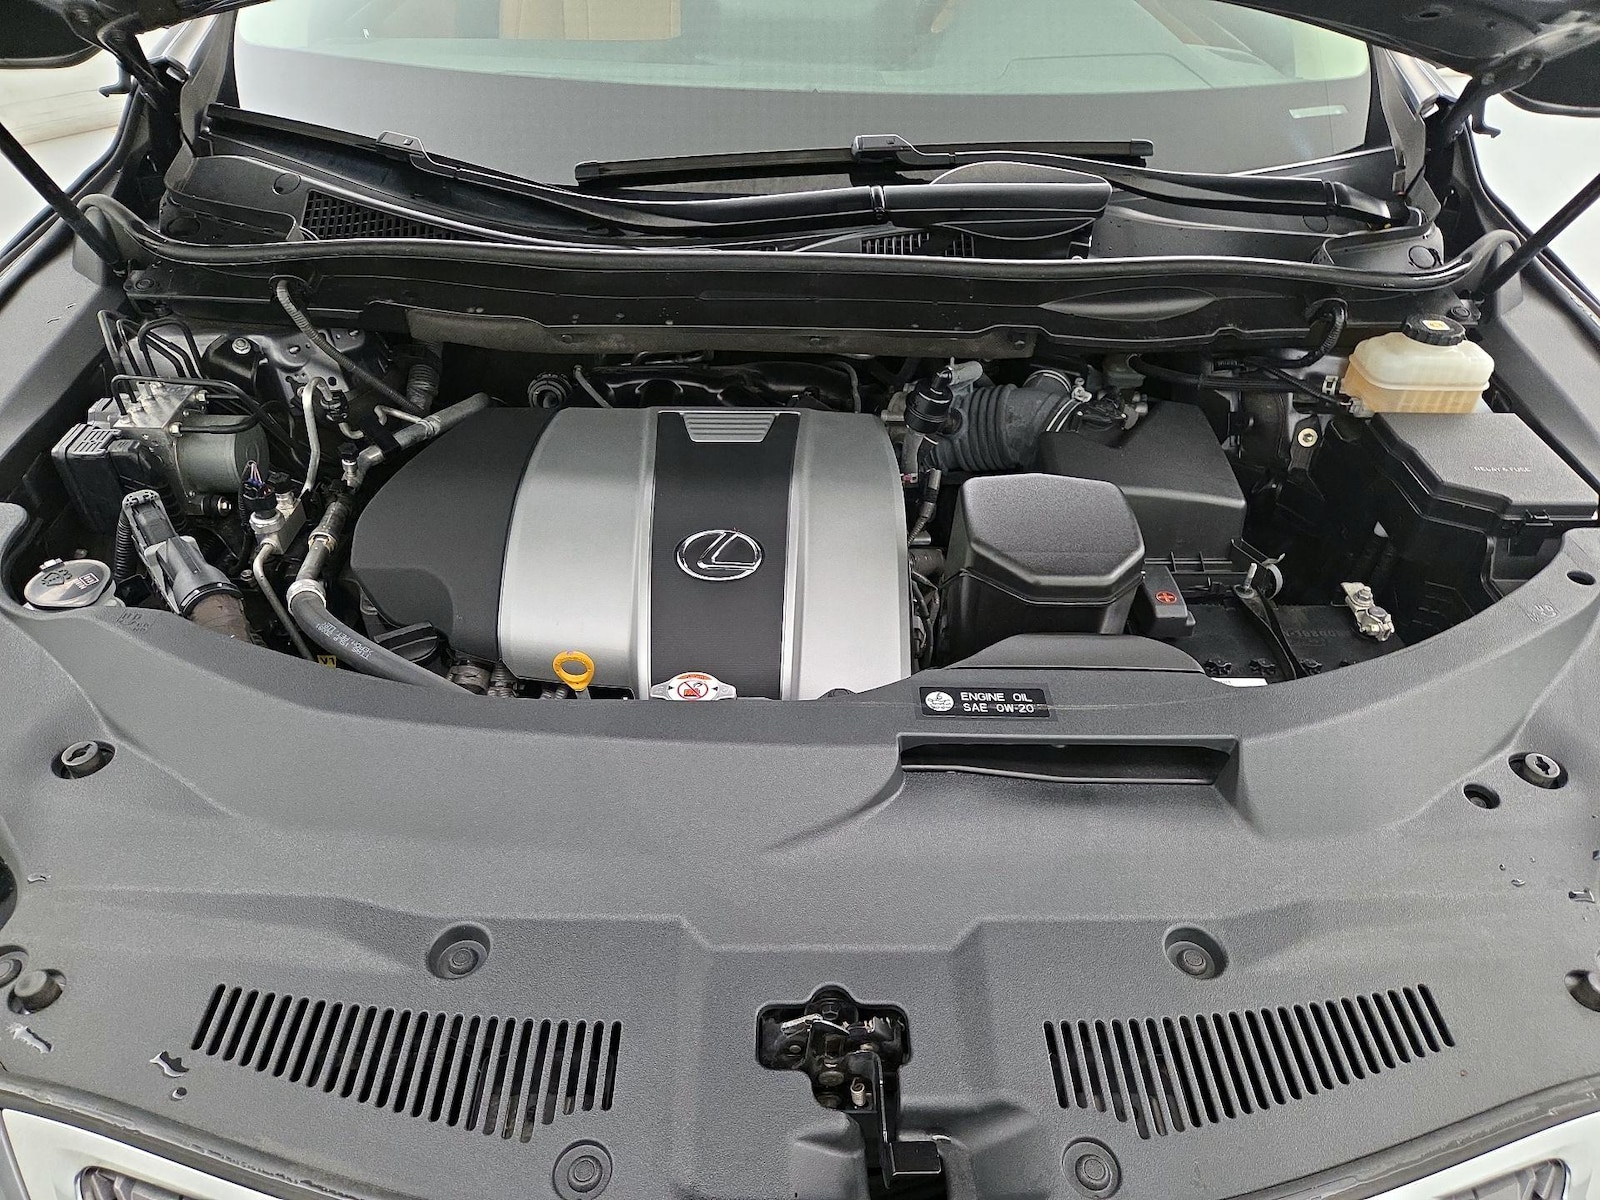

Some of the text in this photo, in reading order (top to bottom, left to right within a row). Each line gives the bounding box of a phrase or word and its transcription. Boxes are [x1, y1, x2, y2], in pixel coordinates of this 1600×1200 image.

[960, 692, 1033, 703] ENGINE OIL
[962, 703, 1035, 713] SAE 0W-20
